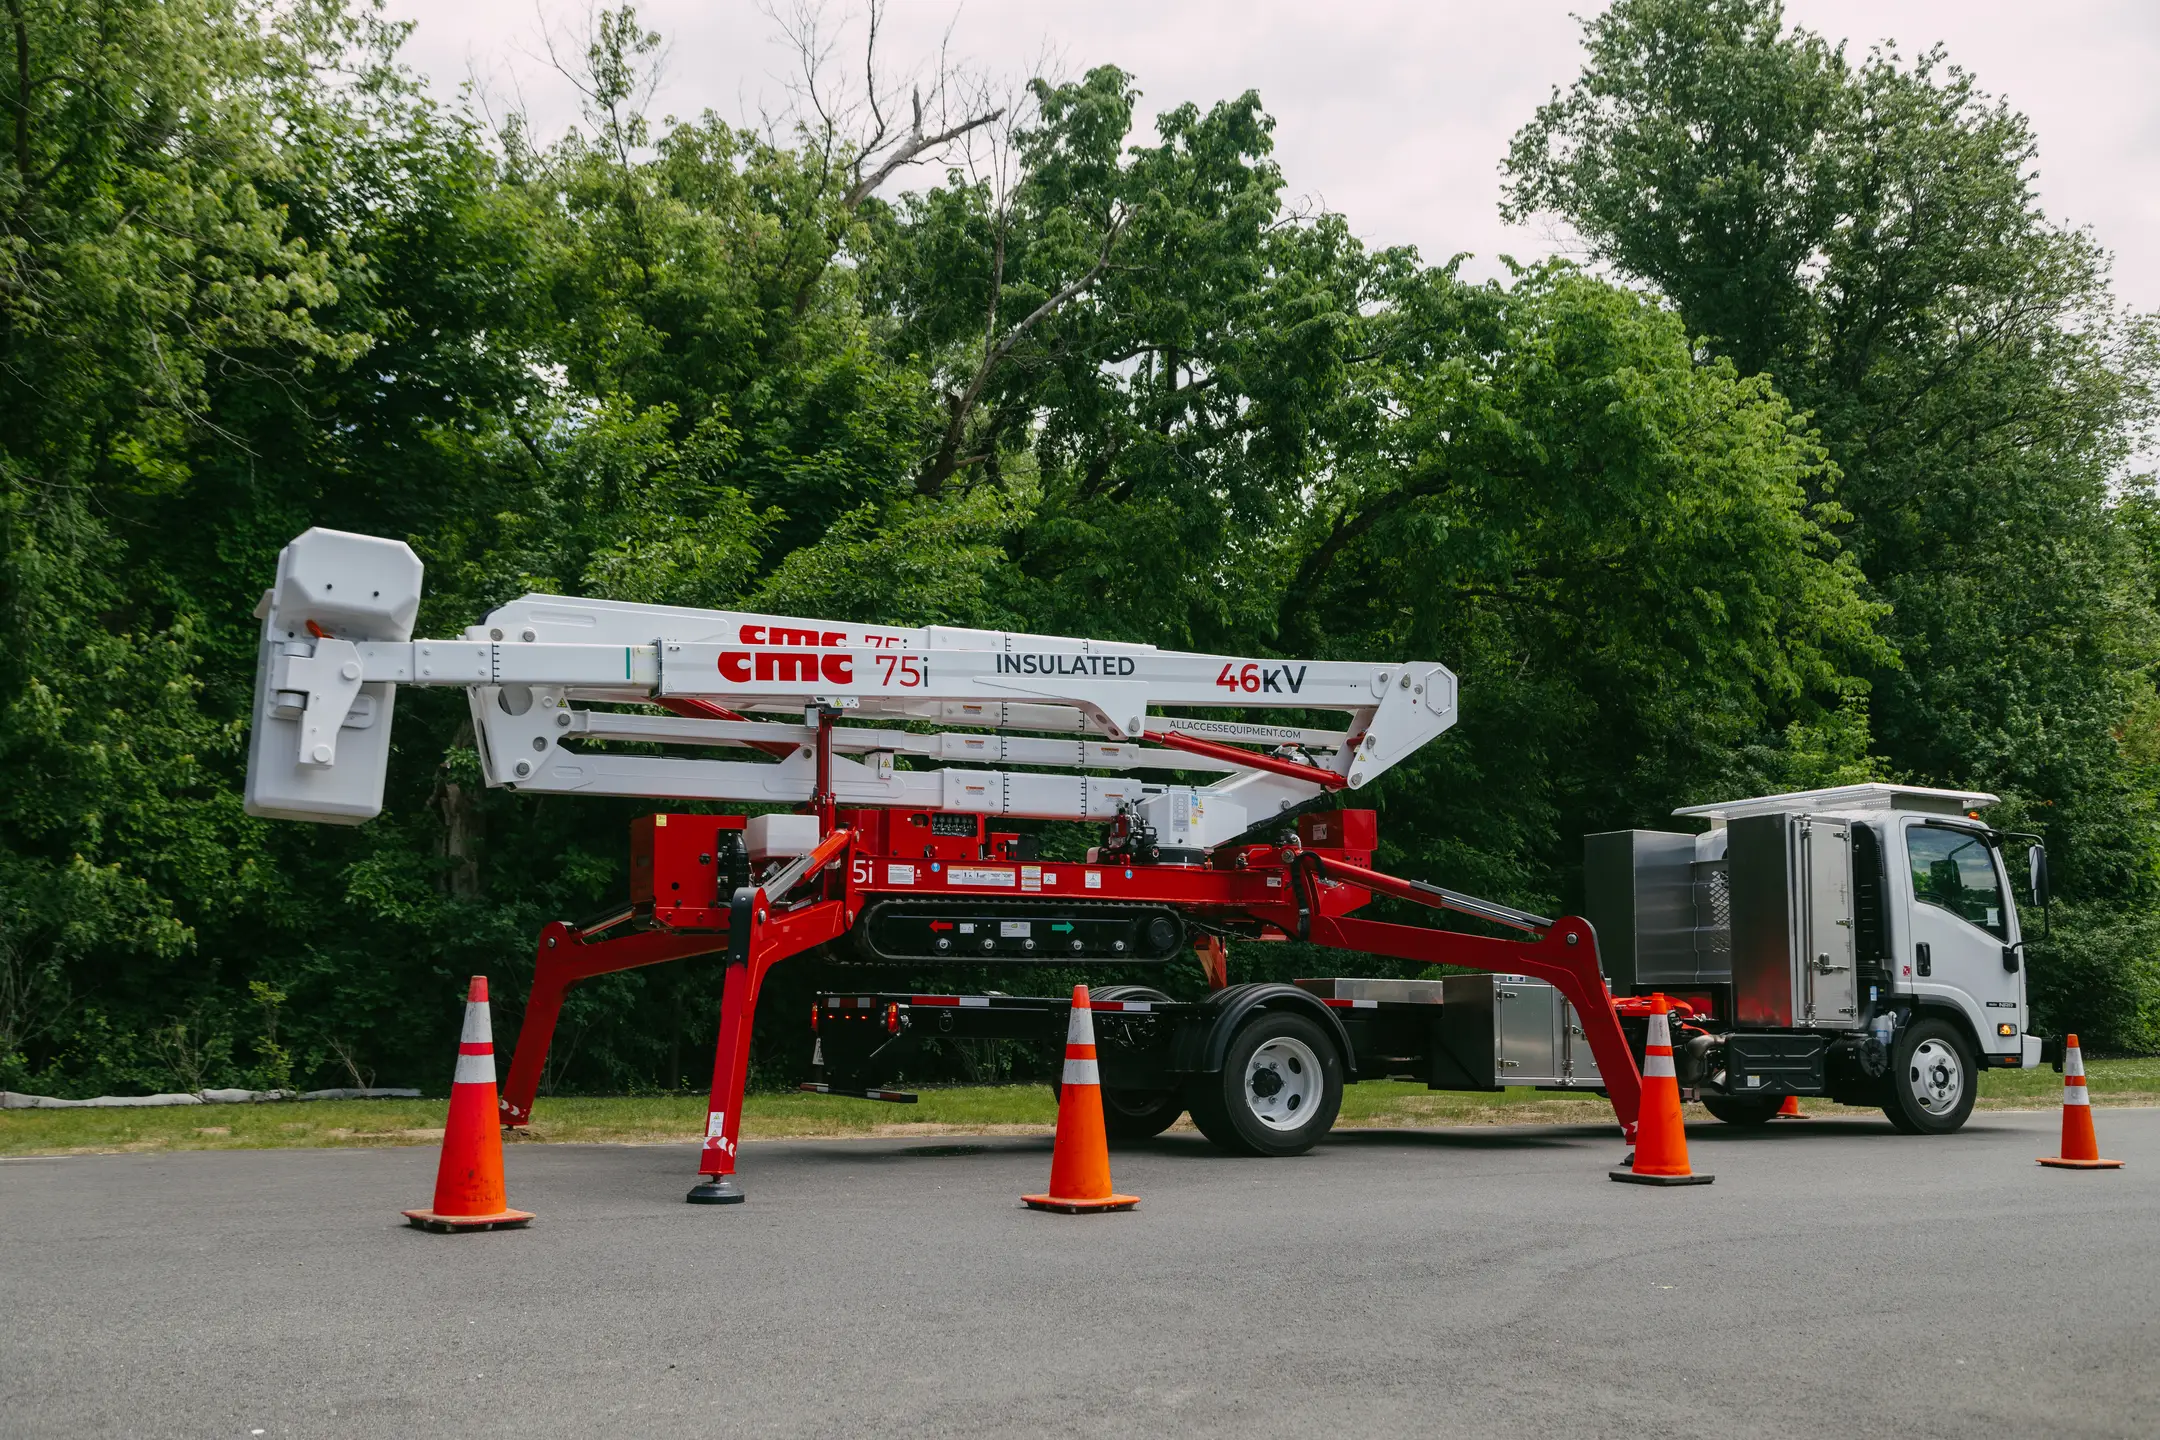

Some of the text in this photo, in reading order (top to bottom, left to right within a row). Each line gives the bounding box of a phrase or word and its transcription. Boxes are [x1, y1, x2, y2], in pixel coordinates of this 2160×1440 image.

[717, 652, 853, 684] cmc
[876, 655, 928, 687] 75i
[996, 654, 1135, 676] INSULATED
[1169, 720, 1301, 739] ALLACCESSEQUIPMENT.COM
